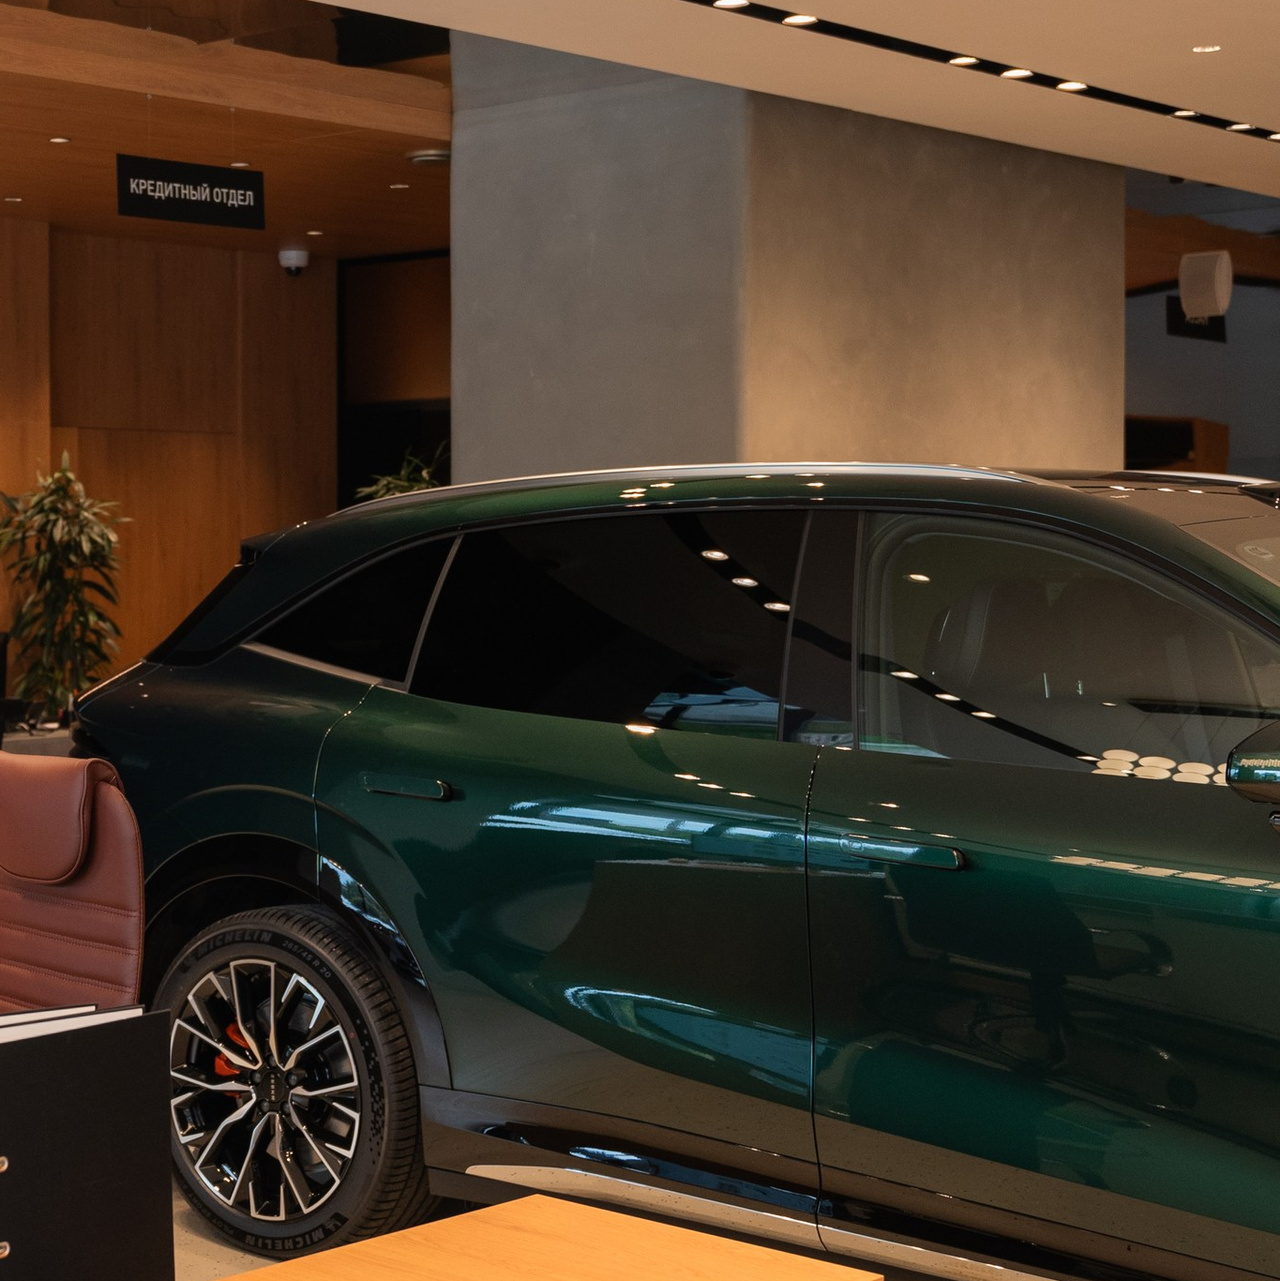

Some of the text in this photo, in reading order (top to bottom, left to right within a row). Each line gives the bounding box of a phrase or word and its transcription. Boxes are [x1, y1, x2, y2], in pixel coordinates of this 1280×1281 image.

[129, 178, 254, 208] КРЕДИТНЫЙ ОТДЕЛ
[245, 1230, 325, 1250] MICHELIN
